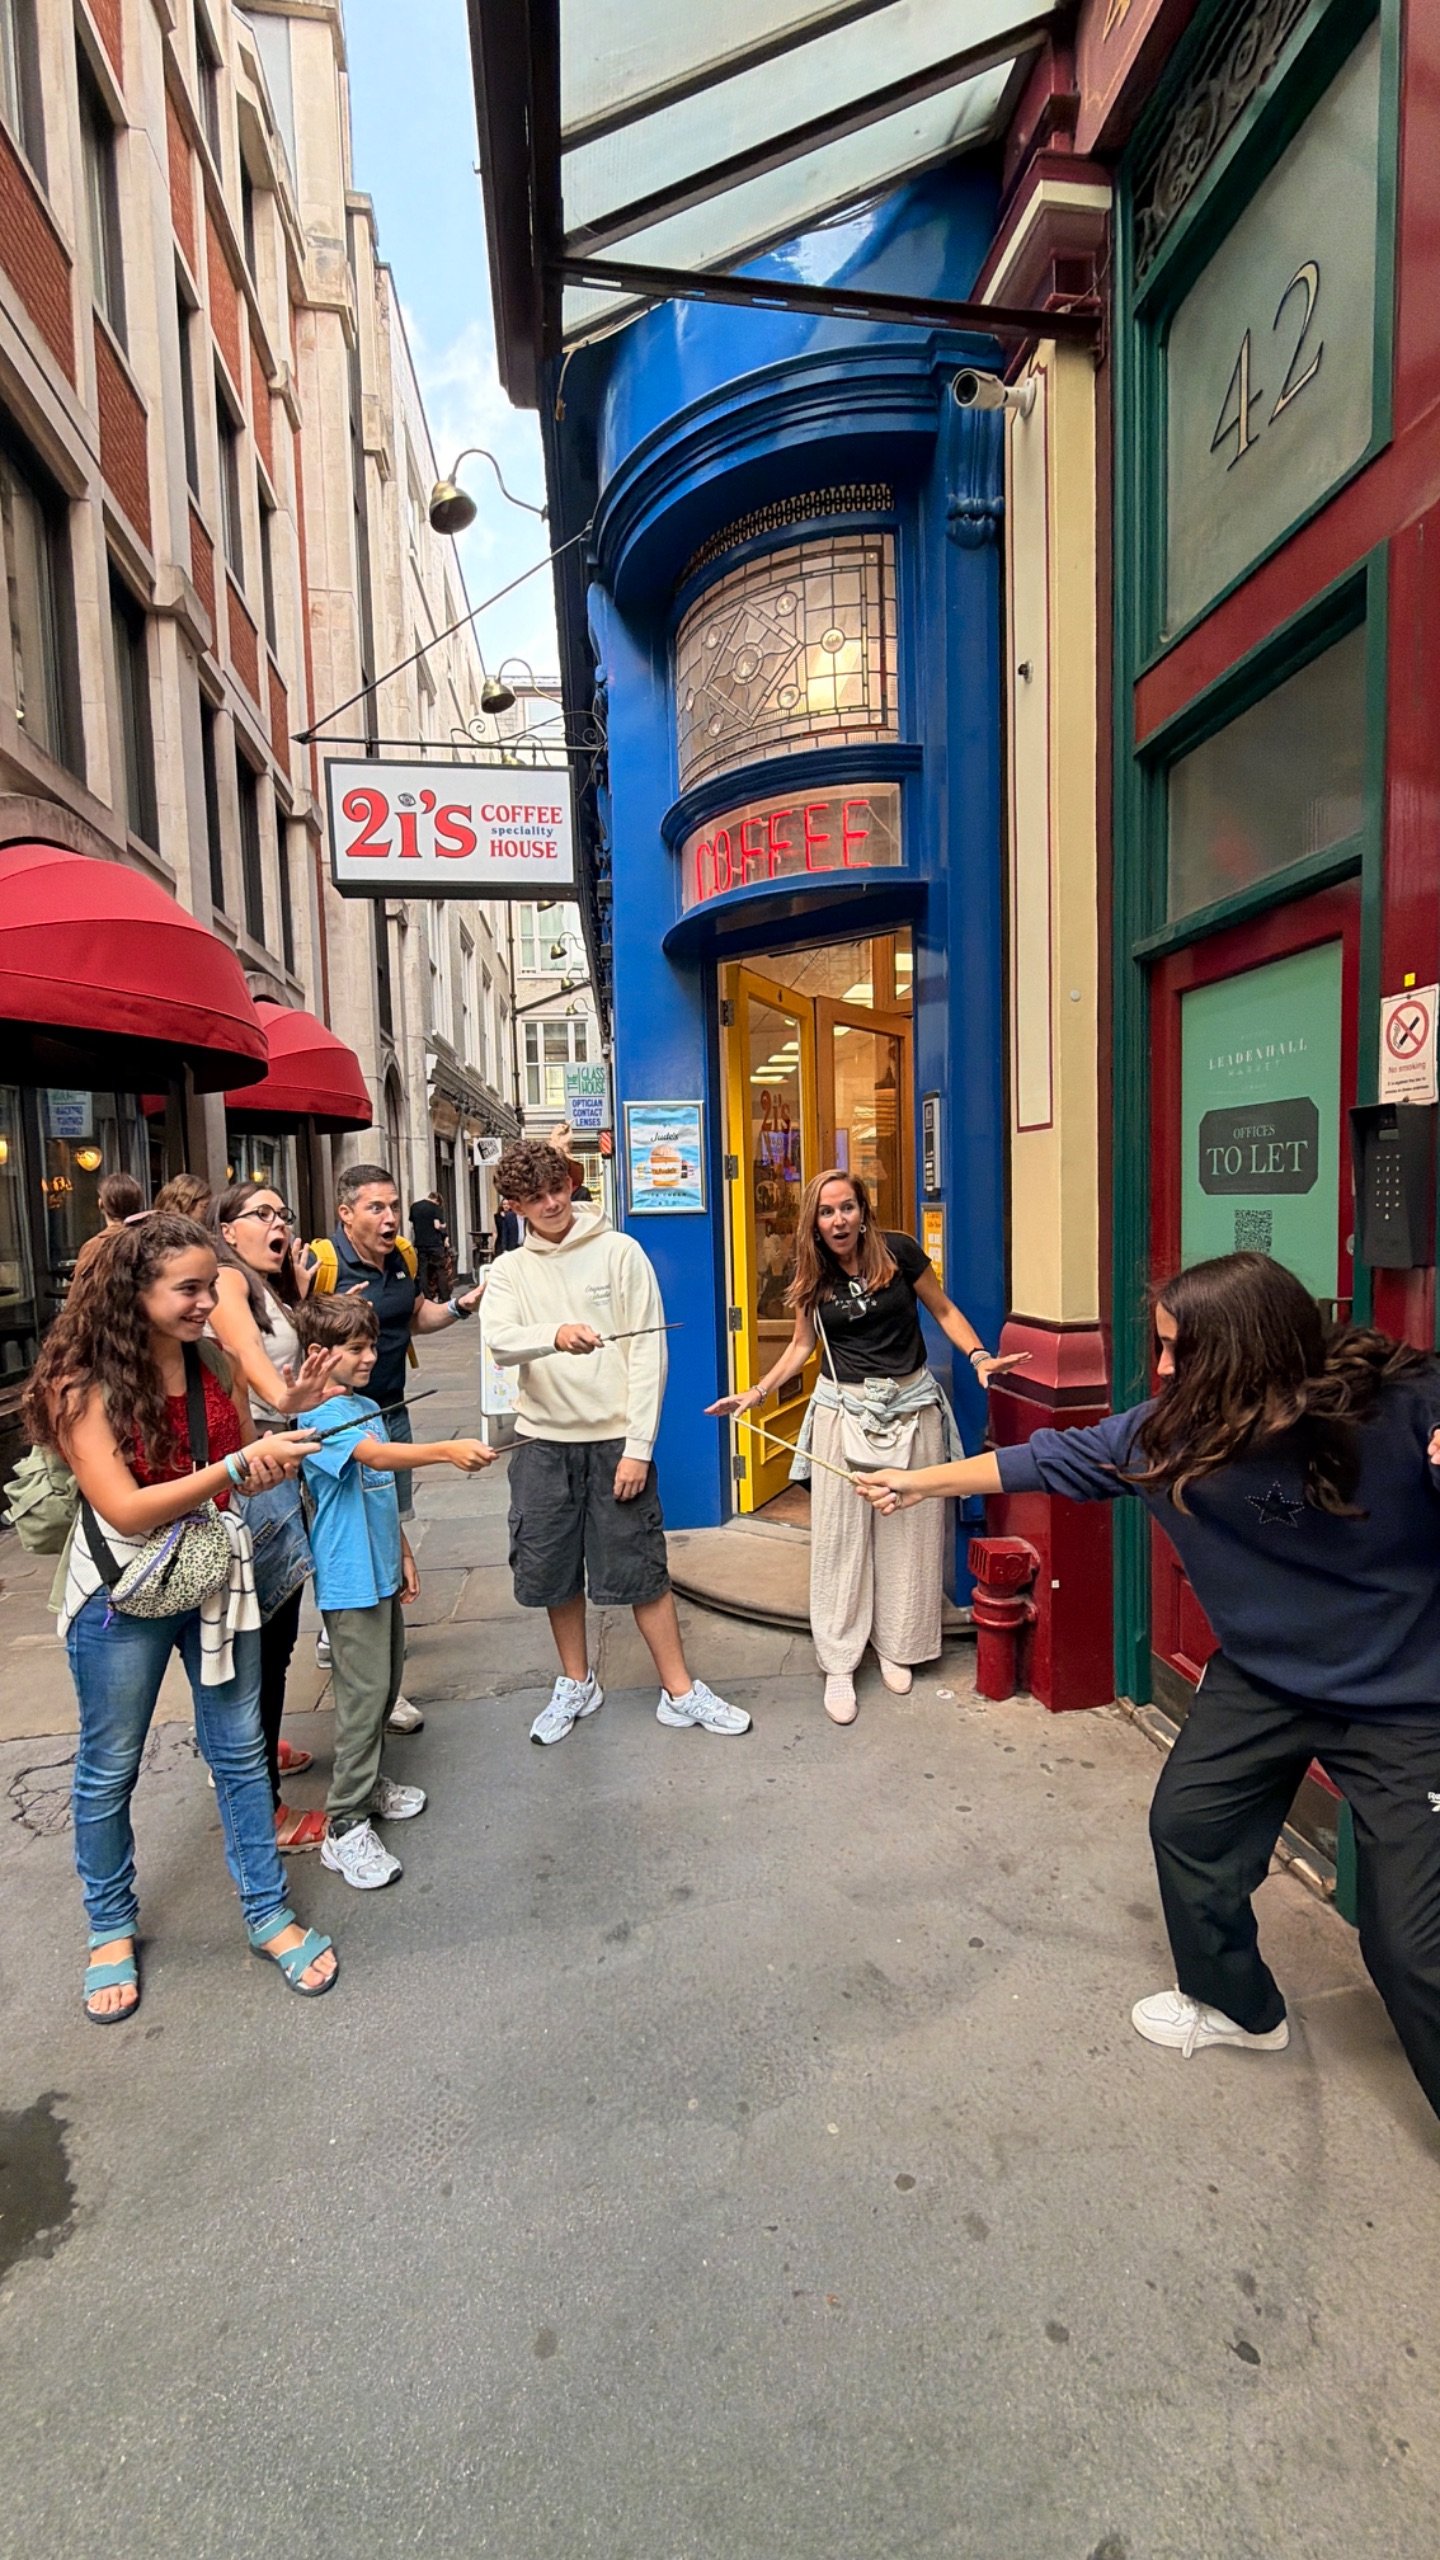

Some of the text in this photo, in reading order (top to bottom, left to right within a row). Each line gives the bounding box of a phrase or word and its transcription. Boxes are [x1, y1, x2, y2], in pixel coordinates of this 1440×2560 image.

[1210, 260, 1324, 471] 42
[480, 804, 563, 824] COFFEE
[491, 825, 554, 838] speciality
[489, 839, 558, 859] HOUSE
[696, 800, 872, 901] COFFEE
[1208, 1038, 1307, 1070] LEADENHALL
[581, 1067, 605, 1080] GLASS
[1387, 1066, 1398, 1074] No
[567, 1074, 578, 1091] THE
[581, 1080, 606, 1095] HOUSE
[572, 1098, 603, 1108] OPTICIAN
[572, 1108, 603, 1117] CONTACT
[575, 1117, 602, 1127] LENSES
[1232, 1123, 1276, 1140] OFFICES
[1206, 1140, 1309, 1176] TO LET
